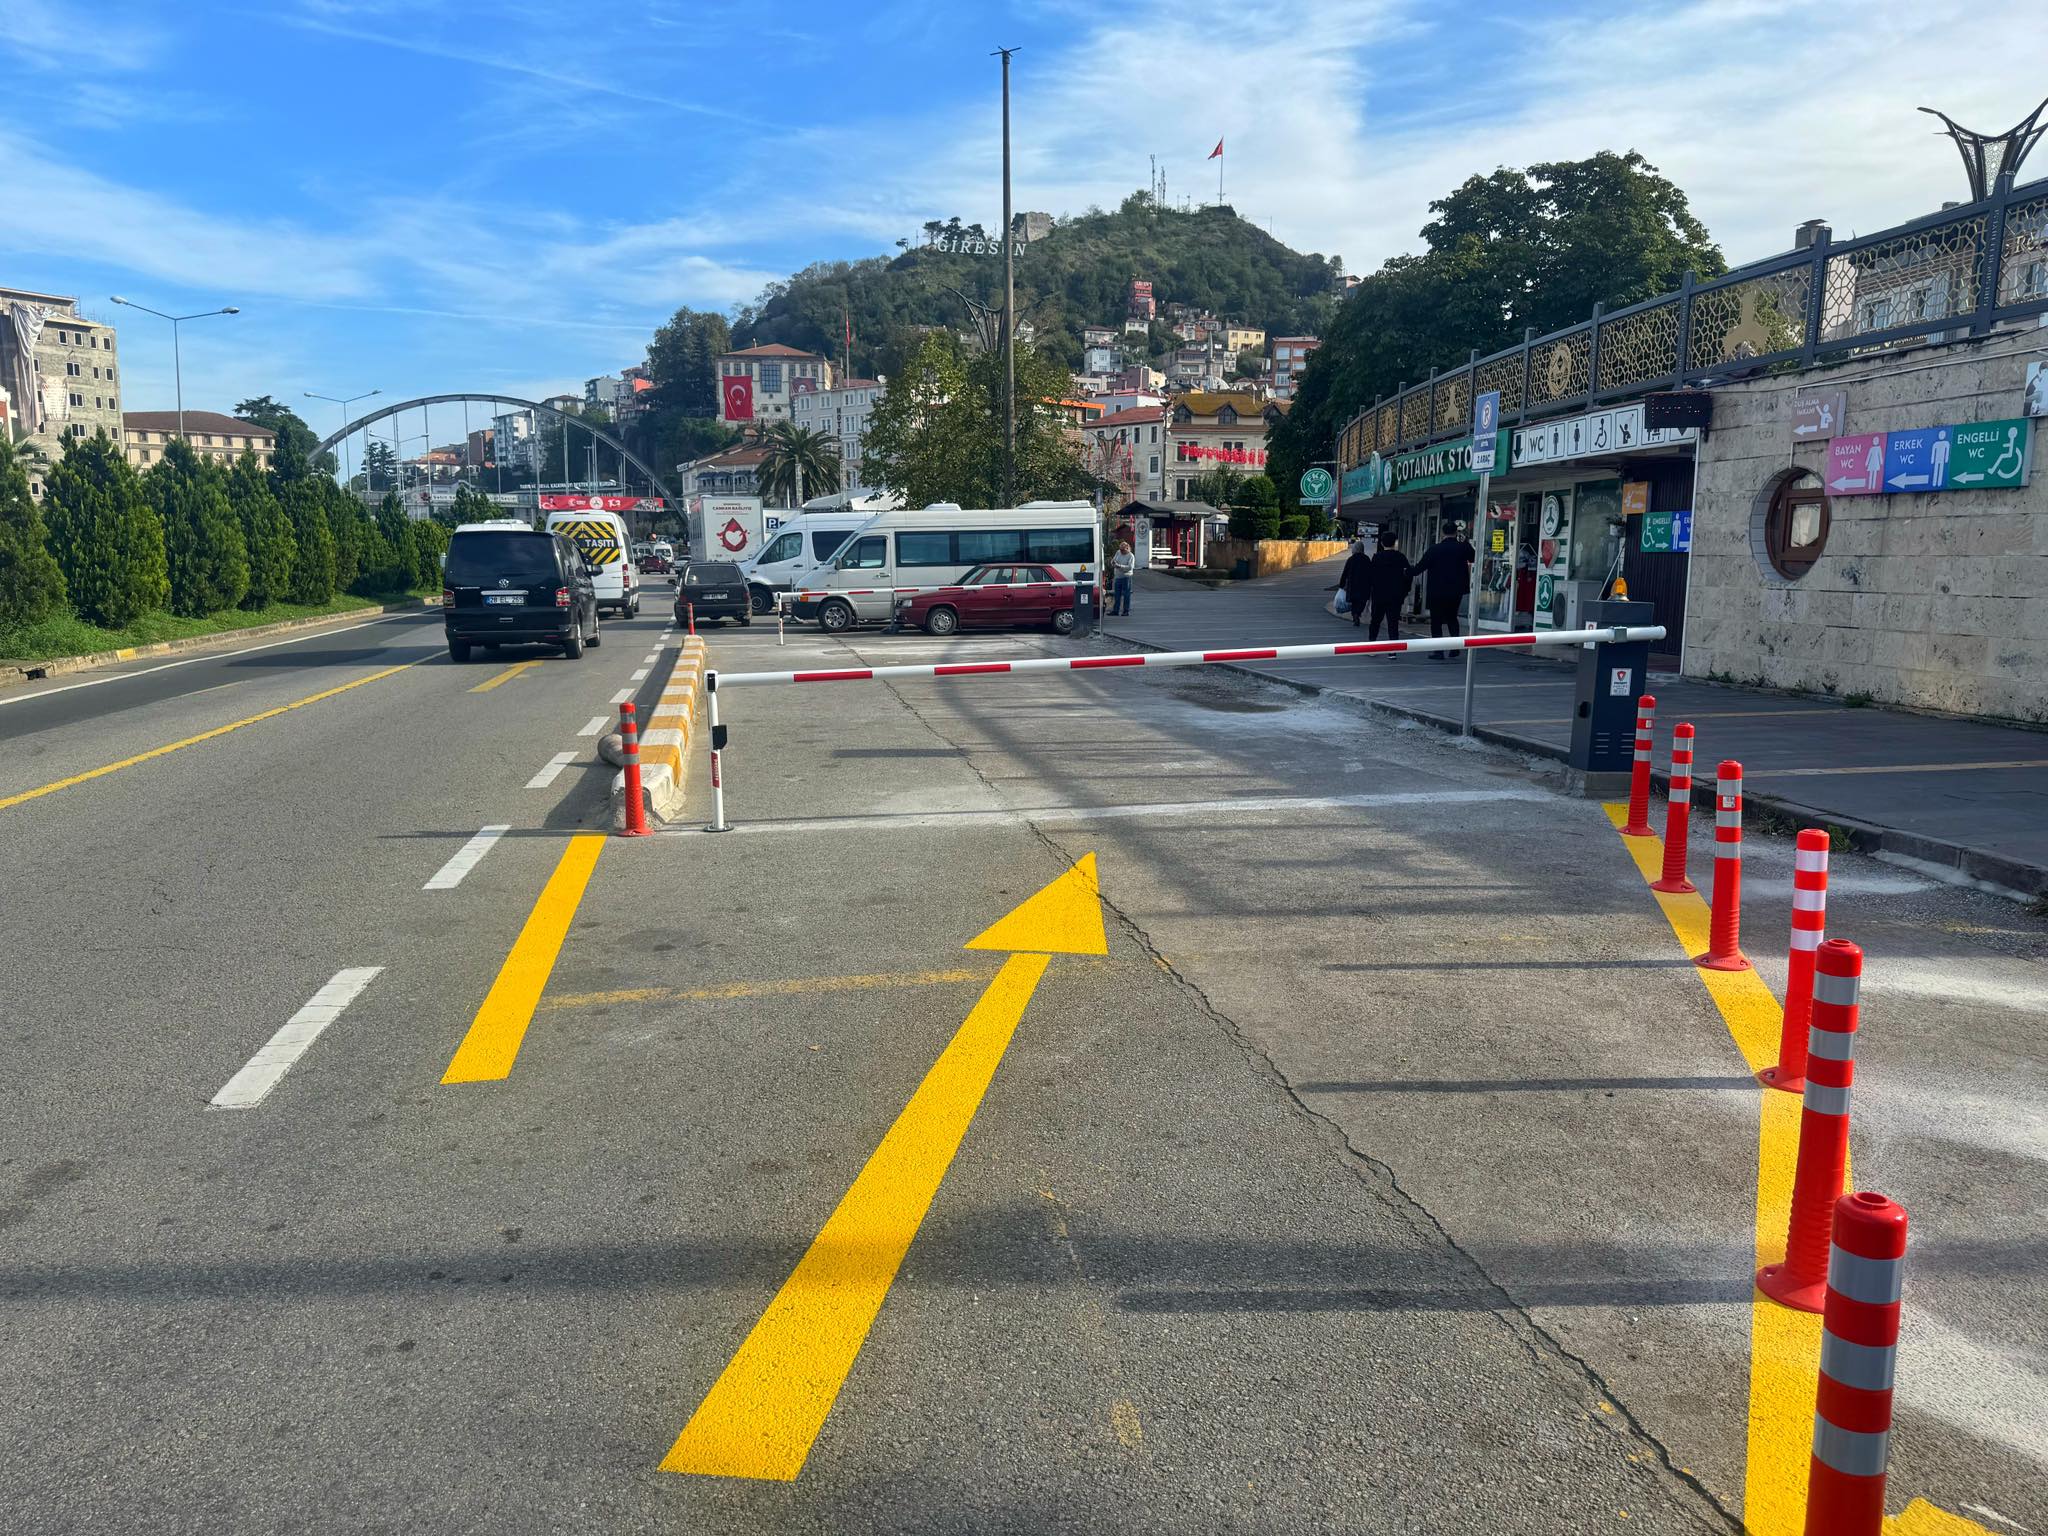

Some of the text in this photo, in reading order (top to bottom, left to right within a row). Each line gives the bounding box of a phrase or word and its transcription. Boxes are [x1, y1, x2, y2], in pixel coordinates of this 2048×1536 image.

[1957, 428, 1999, 444] ENGELLİ
[1529, 435, 1544, 452] WC
[1894, 439, 1924, 450] ERKEK
[1834, 444, 1862, 456] BAYAN
[1968, 448, 1985, 459] WC
[1840, 459, 1854, 468] WC
[1900, 455, 1915, 464] WC
[1396, 451, 1445, 485] ÇOTANAK
[585, 539, 615, 549] TAŞITI
